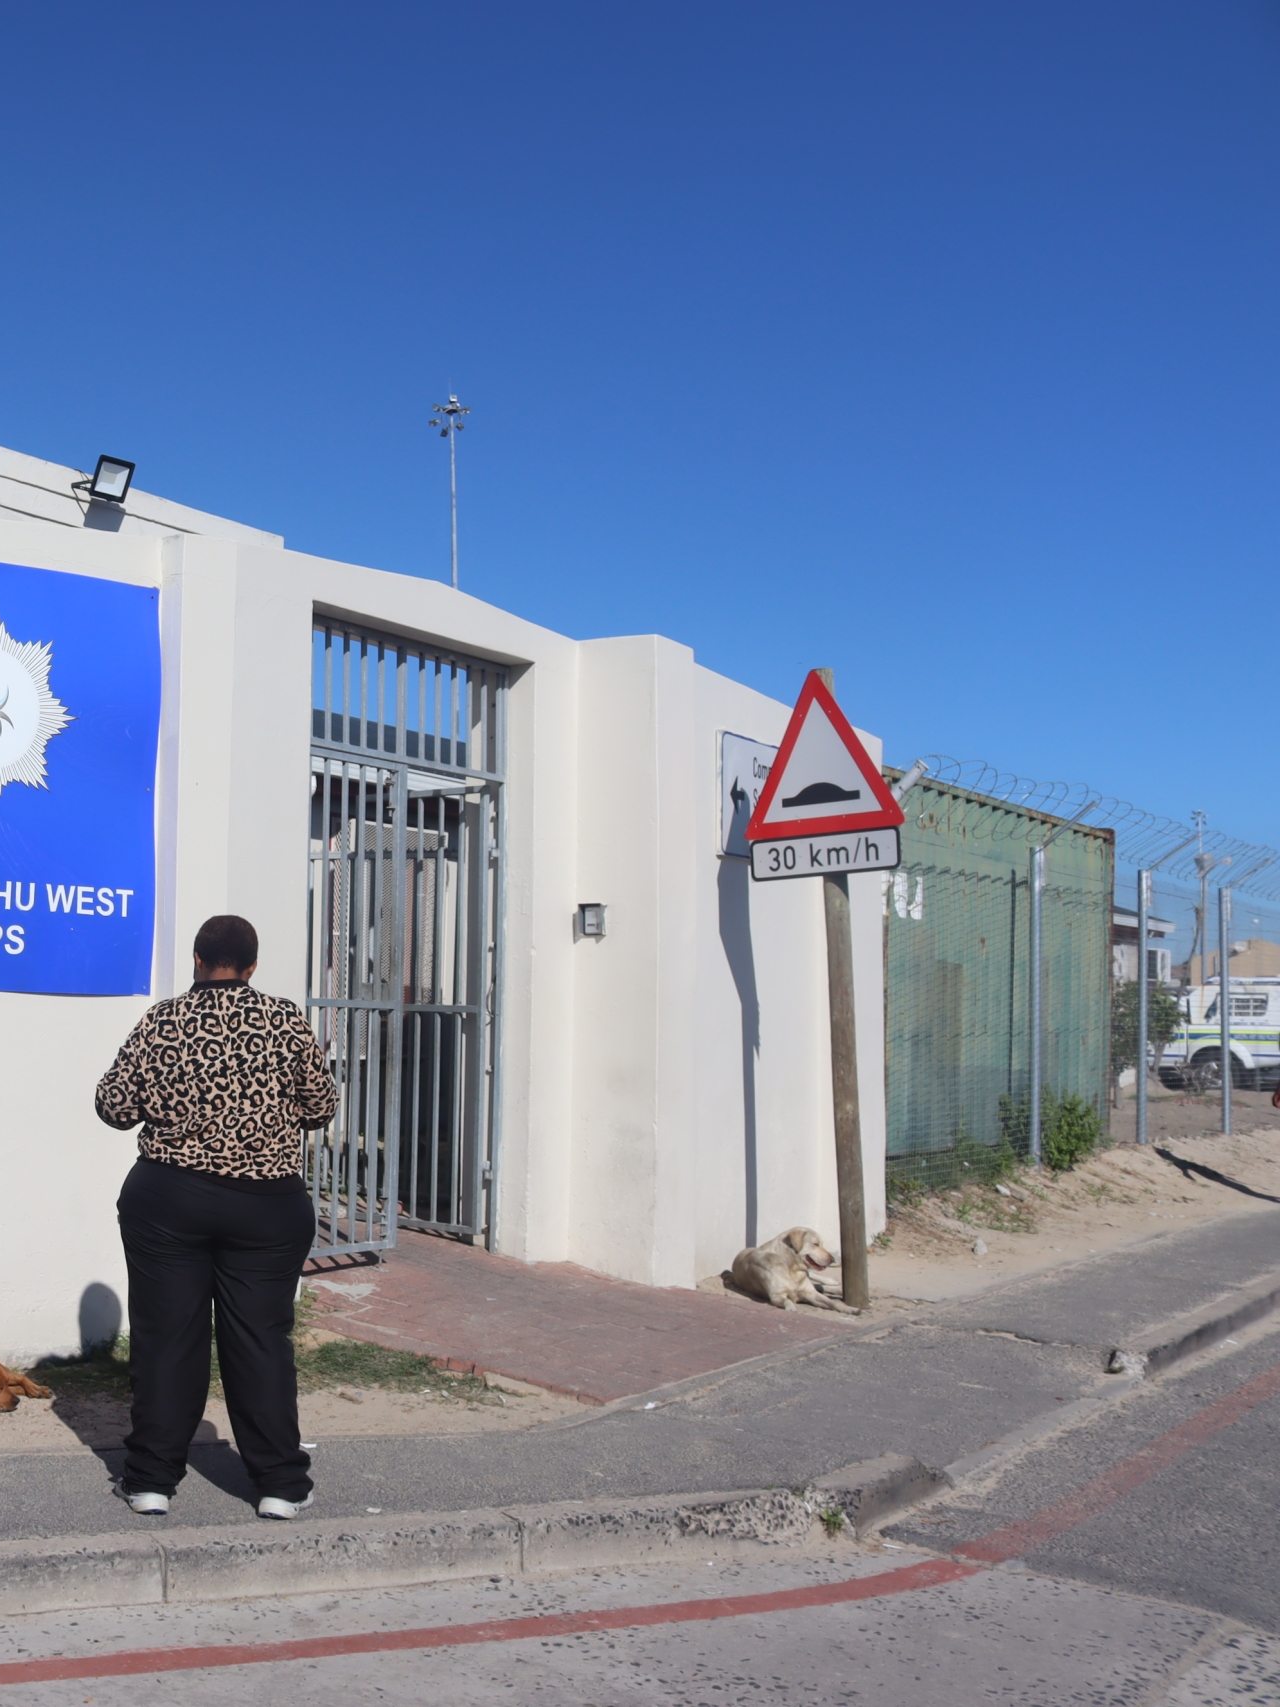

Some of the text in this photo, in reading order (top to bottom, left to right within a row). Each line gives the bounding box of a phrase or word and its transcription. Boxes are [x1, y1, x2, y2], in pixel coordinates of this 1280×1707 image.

[767, 836, 880, 872] 30 km/h
[45, 883, 135, 918] WEST
